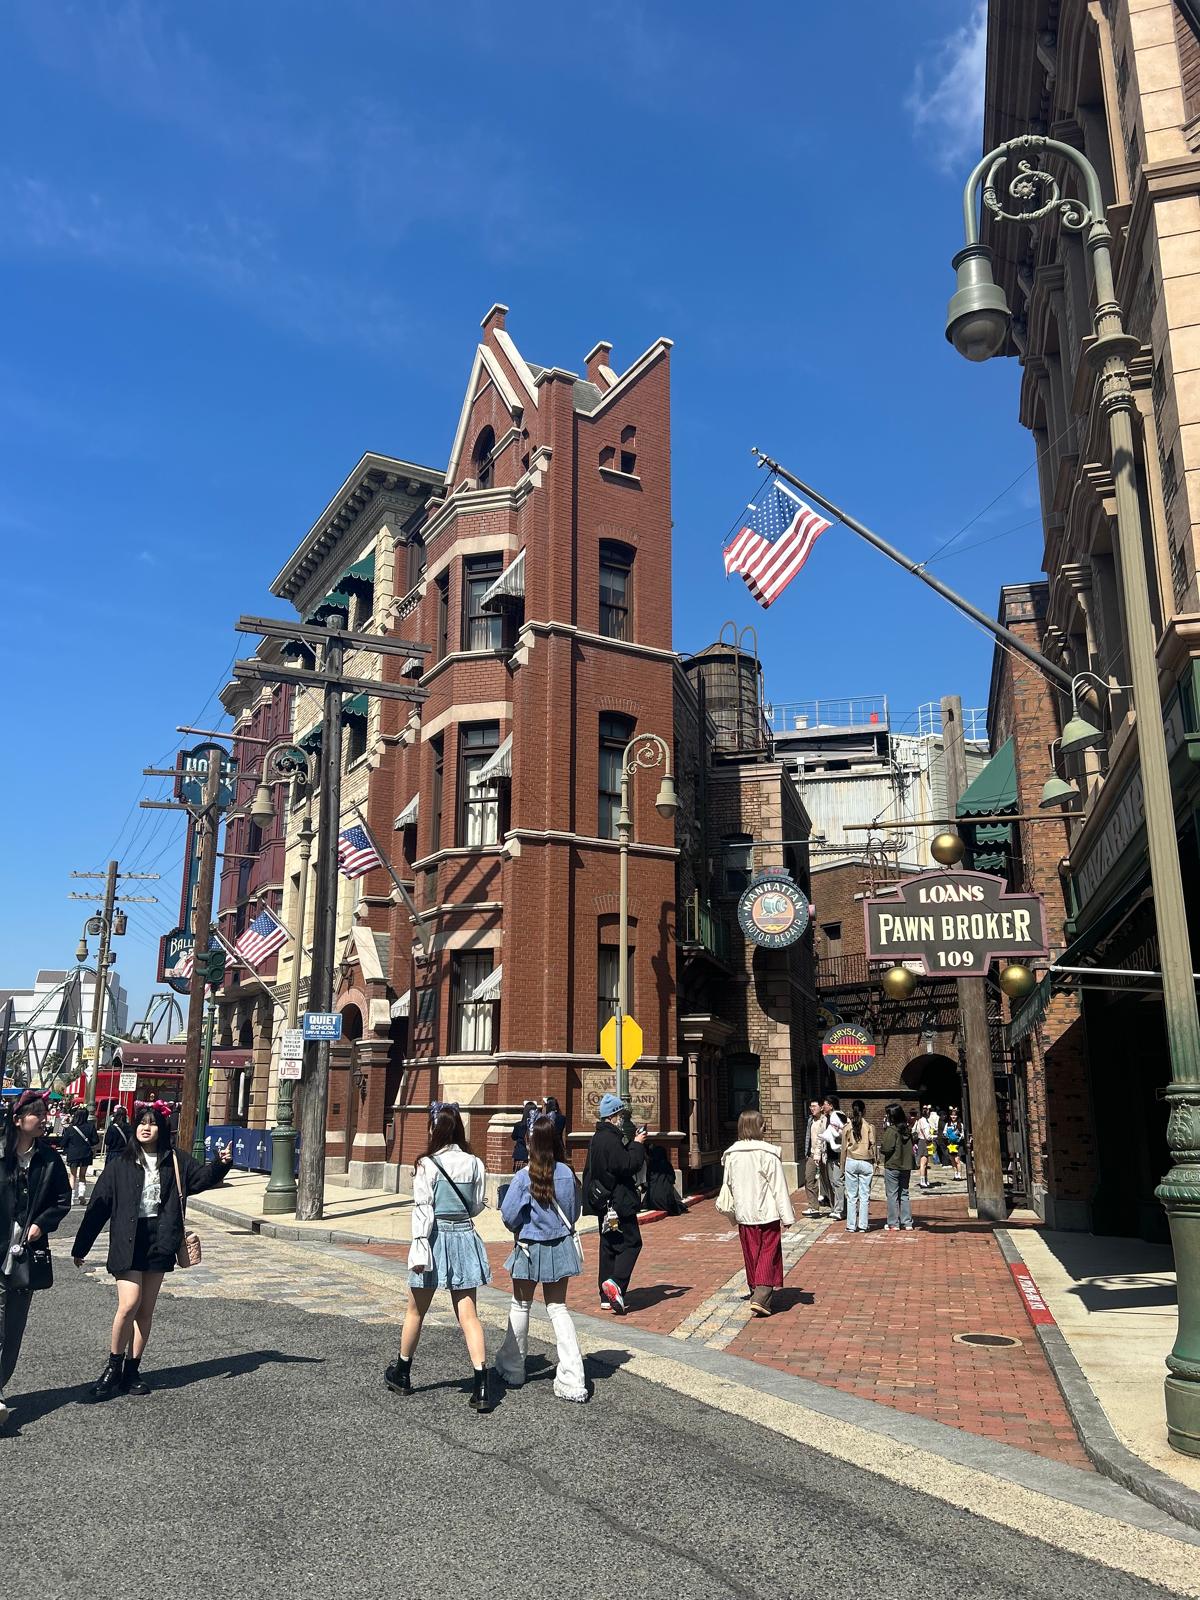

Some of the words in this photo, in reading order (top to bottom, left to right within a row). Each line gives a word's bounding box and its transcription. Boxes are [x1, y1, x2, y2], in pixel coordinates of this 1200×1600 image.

[184, 757, 234, 791] HOL
[743, 882, 804, 912] MANHATTAN
[919, 884, 985, 904] LOANS
[745, 919, 770, 943] MOTOR
[774, 918, 803, 943] REPAIR
[879, 913, 935, 945] PAWN
[941, 909, 1032, 942] BROKER
[937, 950, 974, 967] 109
[309, 1015, 338, 1025] QUIET
[830, 1027, 867, 1044] CHRYSLER
[280, 1067, 286, 1076] U
[832, 1058, 867, 1072] PLYMOUTH
